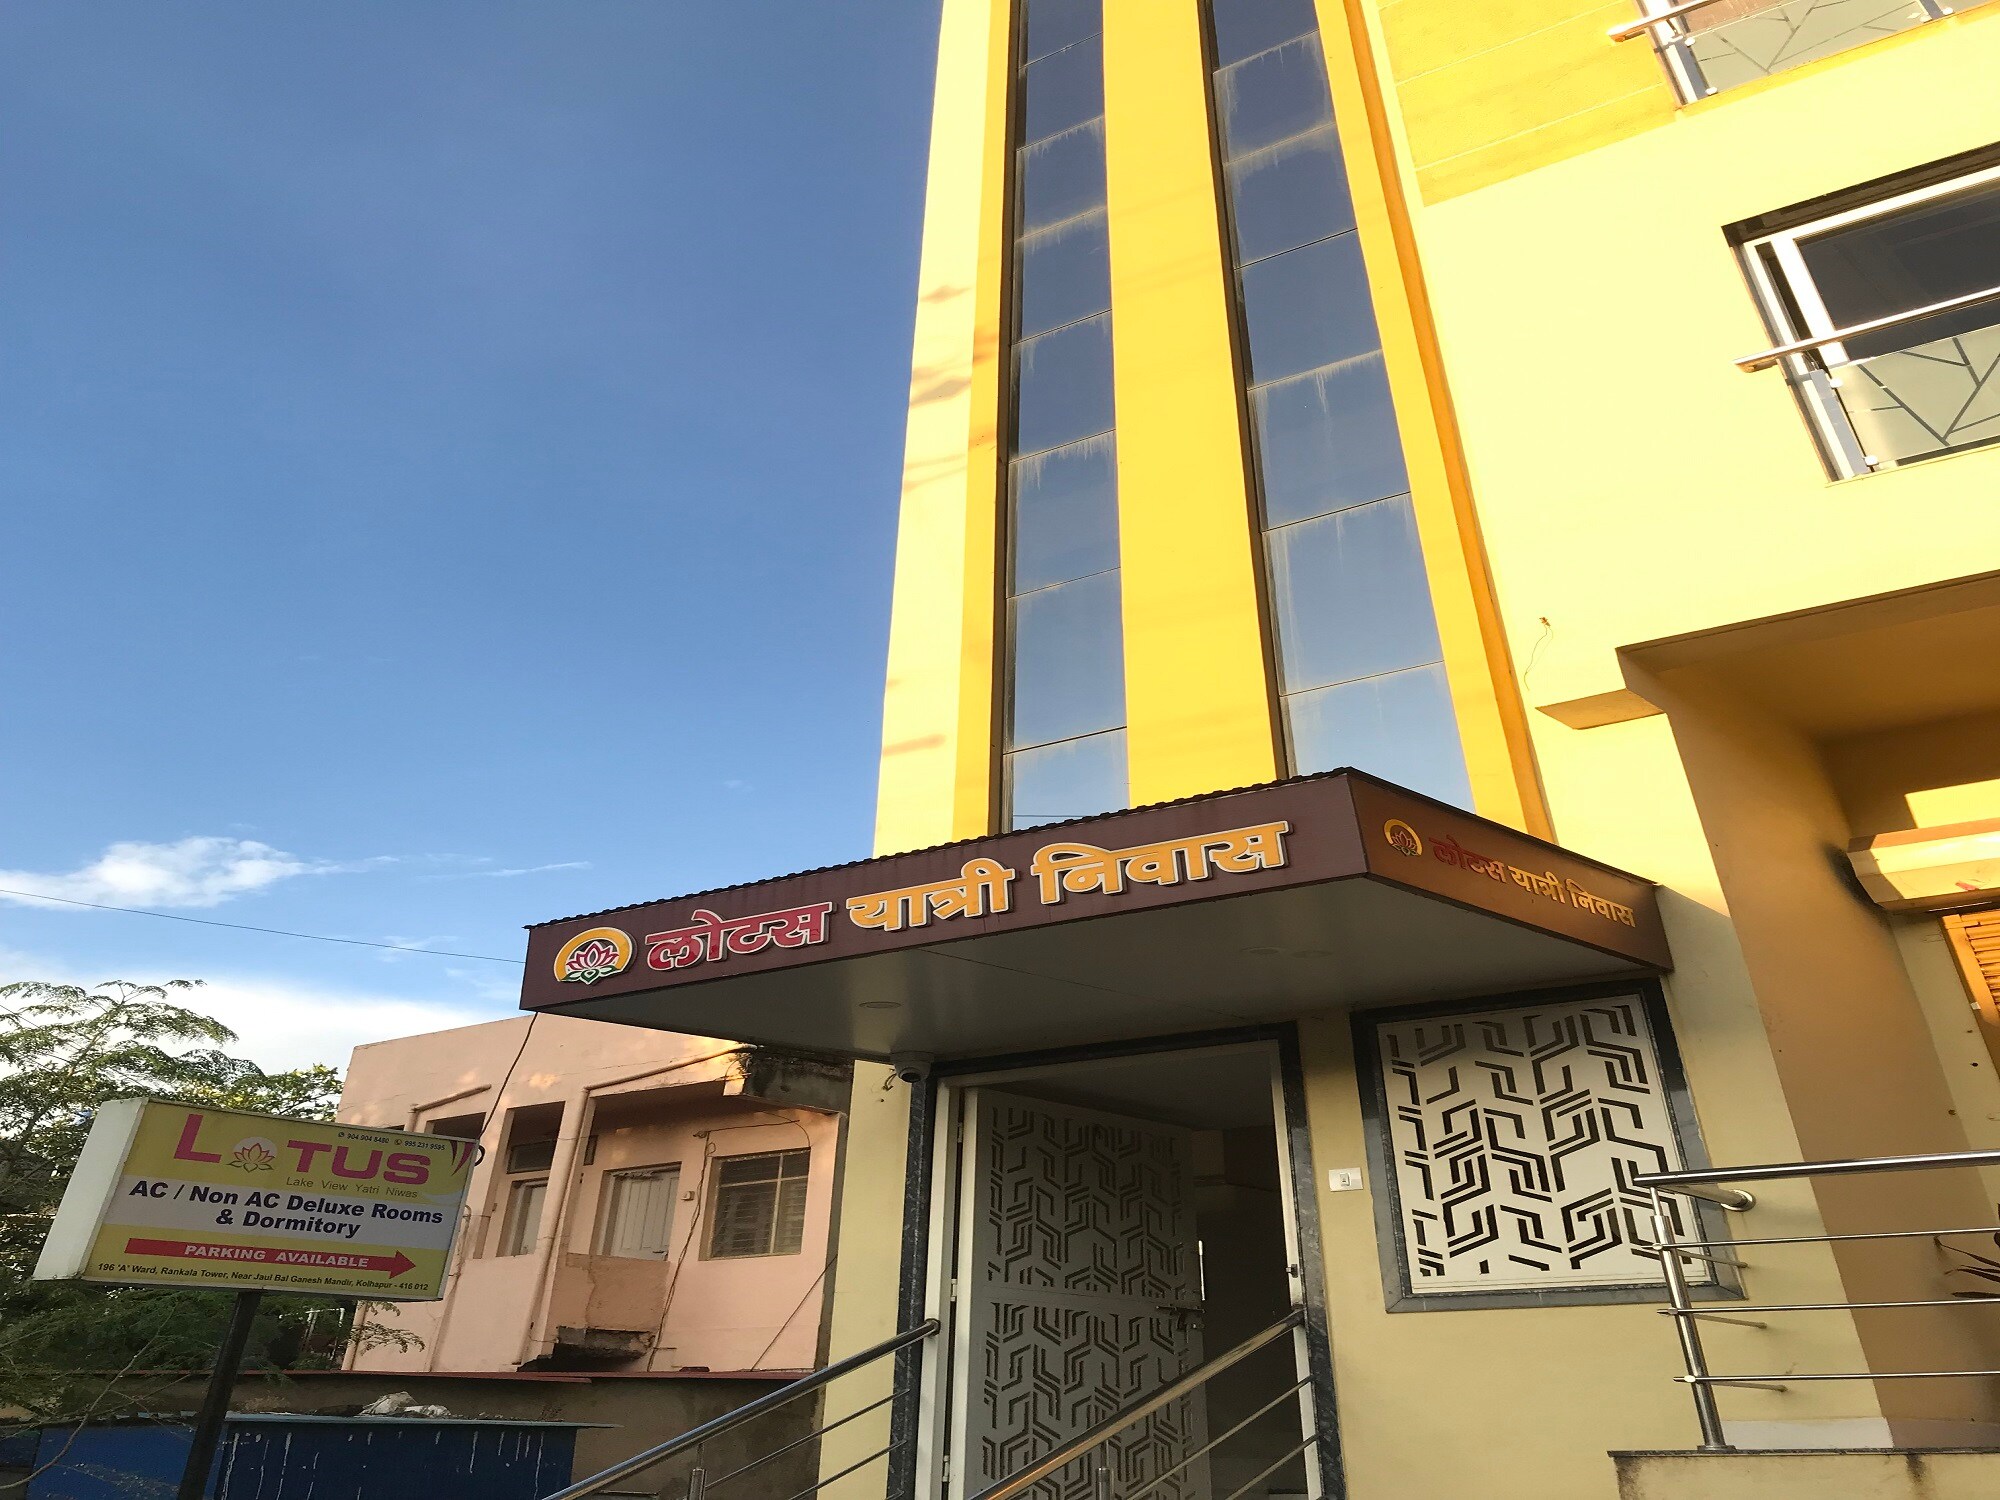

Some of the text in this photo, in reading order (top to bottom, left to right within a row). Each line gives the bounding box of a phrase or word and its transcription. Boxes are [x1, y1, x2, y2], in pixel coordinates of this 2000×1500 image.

[645, 819, 1293, 972] लोटस यात्री निवास
[1428, 835, 1636, 928] लोटस यात्री निवास
[128, 1180, 443, 1225] AC / Non AC Deluxe Rooms
[286, 1176, 418, 1199] Lake View Yatri Niwas
[215, 1208, 361, 1239] & Dormitory
[184, 1245, 369, 1267] PARKING AVAILABLE
[98, 1263, 114, 1271] 196
[132, 1265, 158, 1275] Ward,
[160, 1267, 198, 1277] Rankala
[200, 1270, 229, 1279] Tower,
[231, 1272, 253, 1280] Near
[290, 1275, 322, 1285] Ganesh
[324, 1278, 353, 1288] Mandir,
[355, 1279, 392, 1290] Kolhapur
[398, 1282, 413, 1290] 416
[413, 1283, 429, 1291] 012
